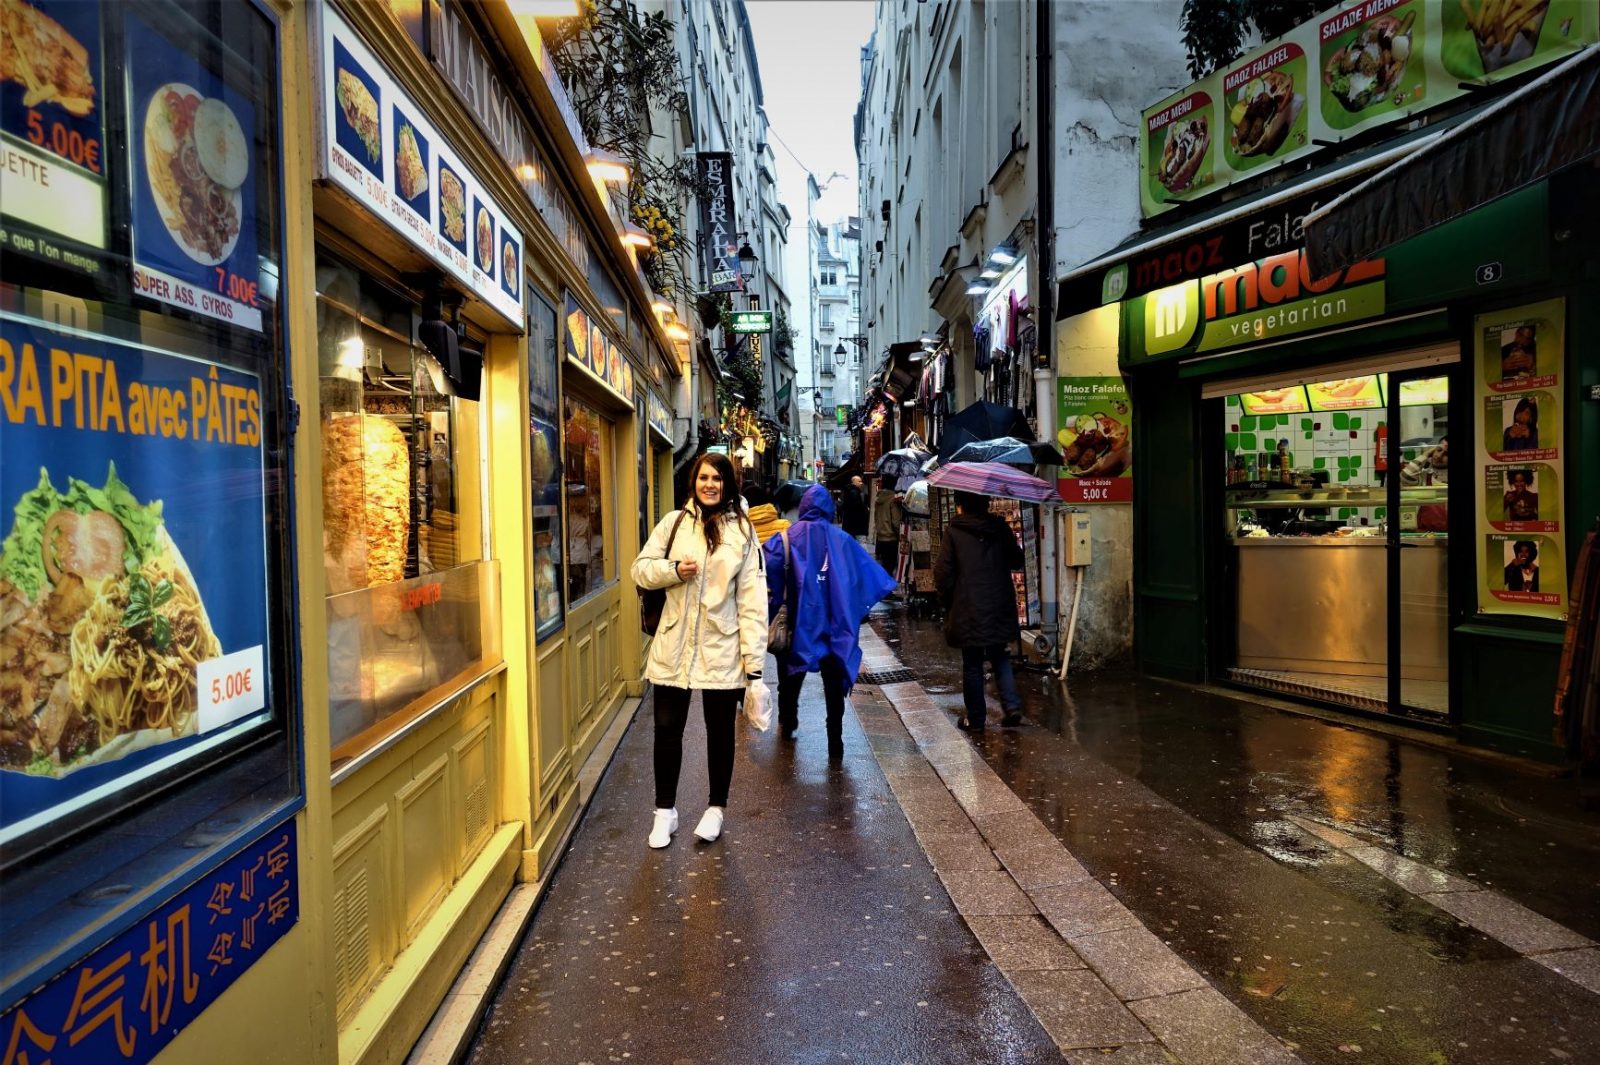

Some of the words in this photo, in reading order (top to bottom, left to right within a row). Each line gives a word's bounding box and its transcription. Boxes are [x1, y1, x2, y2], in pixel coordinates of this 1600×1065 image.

[1322, 8, 1363, 40] SALADE
[1226, 70, 1250, 91] MAOZ
[1252, 48, 1289, 76] FALAFEL
[1149, 111, 1170, 131] MAOZ
[1171, 101, 1192, 121] MENU
[27, 110, 100, 173] 5.00€
[13, 233, 35, 250] que
[39, 239, 59, 258] l'on
[64, 252, 99, 273] mange
[1135, 235, 1224, 289] maoz
[1248, 201, 1320, 254] Fala
[215, 267, 258, 306] 7.00€
[714, 271, 736, 284] BAR
[1483, 266, 1494, 281] 8
[134, 271, 170, 299] SUPER
[175, 284, 198, 308] ASS.
[202, 294, 233, 319] GYROS
[1231, 296, 1347, 337] vegetarian
[50, 348, 126, 433] PITA
[128, 381, 188, 440] avec
[191, 361, 260, 448] PÂTES
[1064, 385, 1090, 394] Maoz
[1092, 384, 1126, 394] Falafel
[1083, 488, 1100, 500] 5,00
[1102, 488, 1108, 499] €
[211, 668, 252, 706] 5.00€
